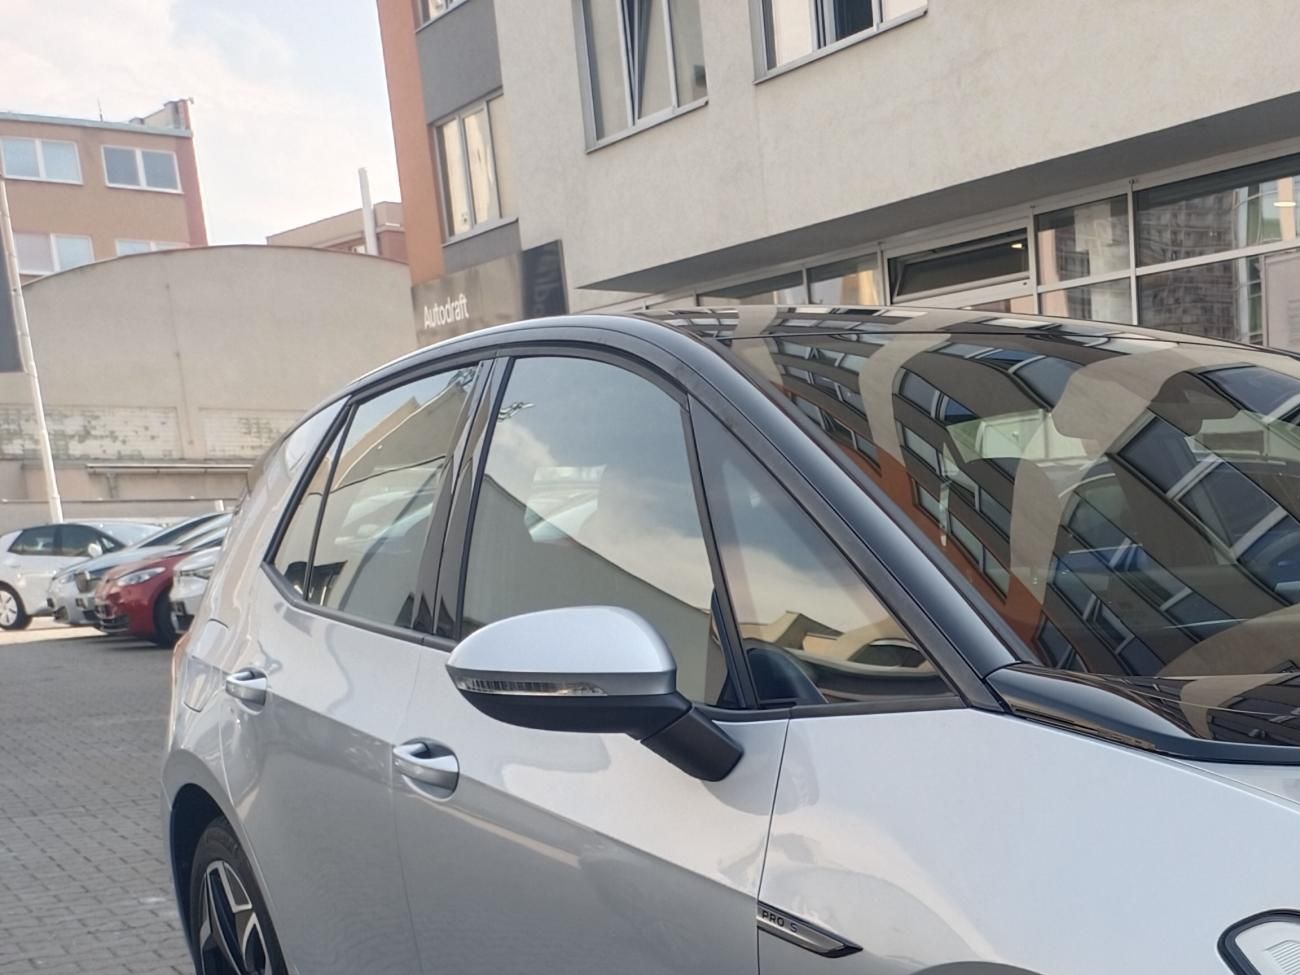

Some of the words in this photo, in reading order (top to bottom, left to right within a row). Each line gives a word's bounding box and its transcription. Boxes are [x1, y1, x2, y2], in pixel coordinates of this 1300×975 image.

[423, 293, 469, 330] Autodraft
[762, 910, 785, 928] PRO
[789, 921, 799, 934] S
